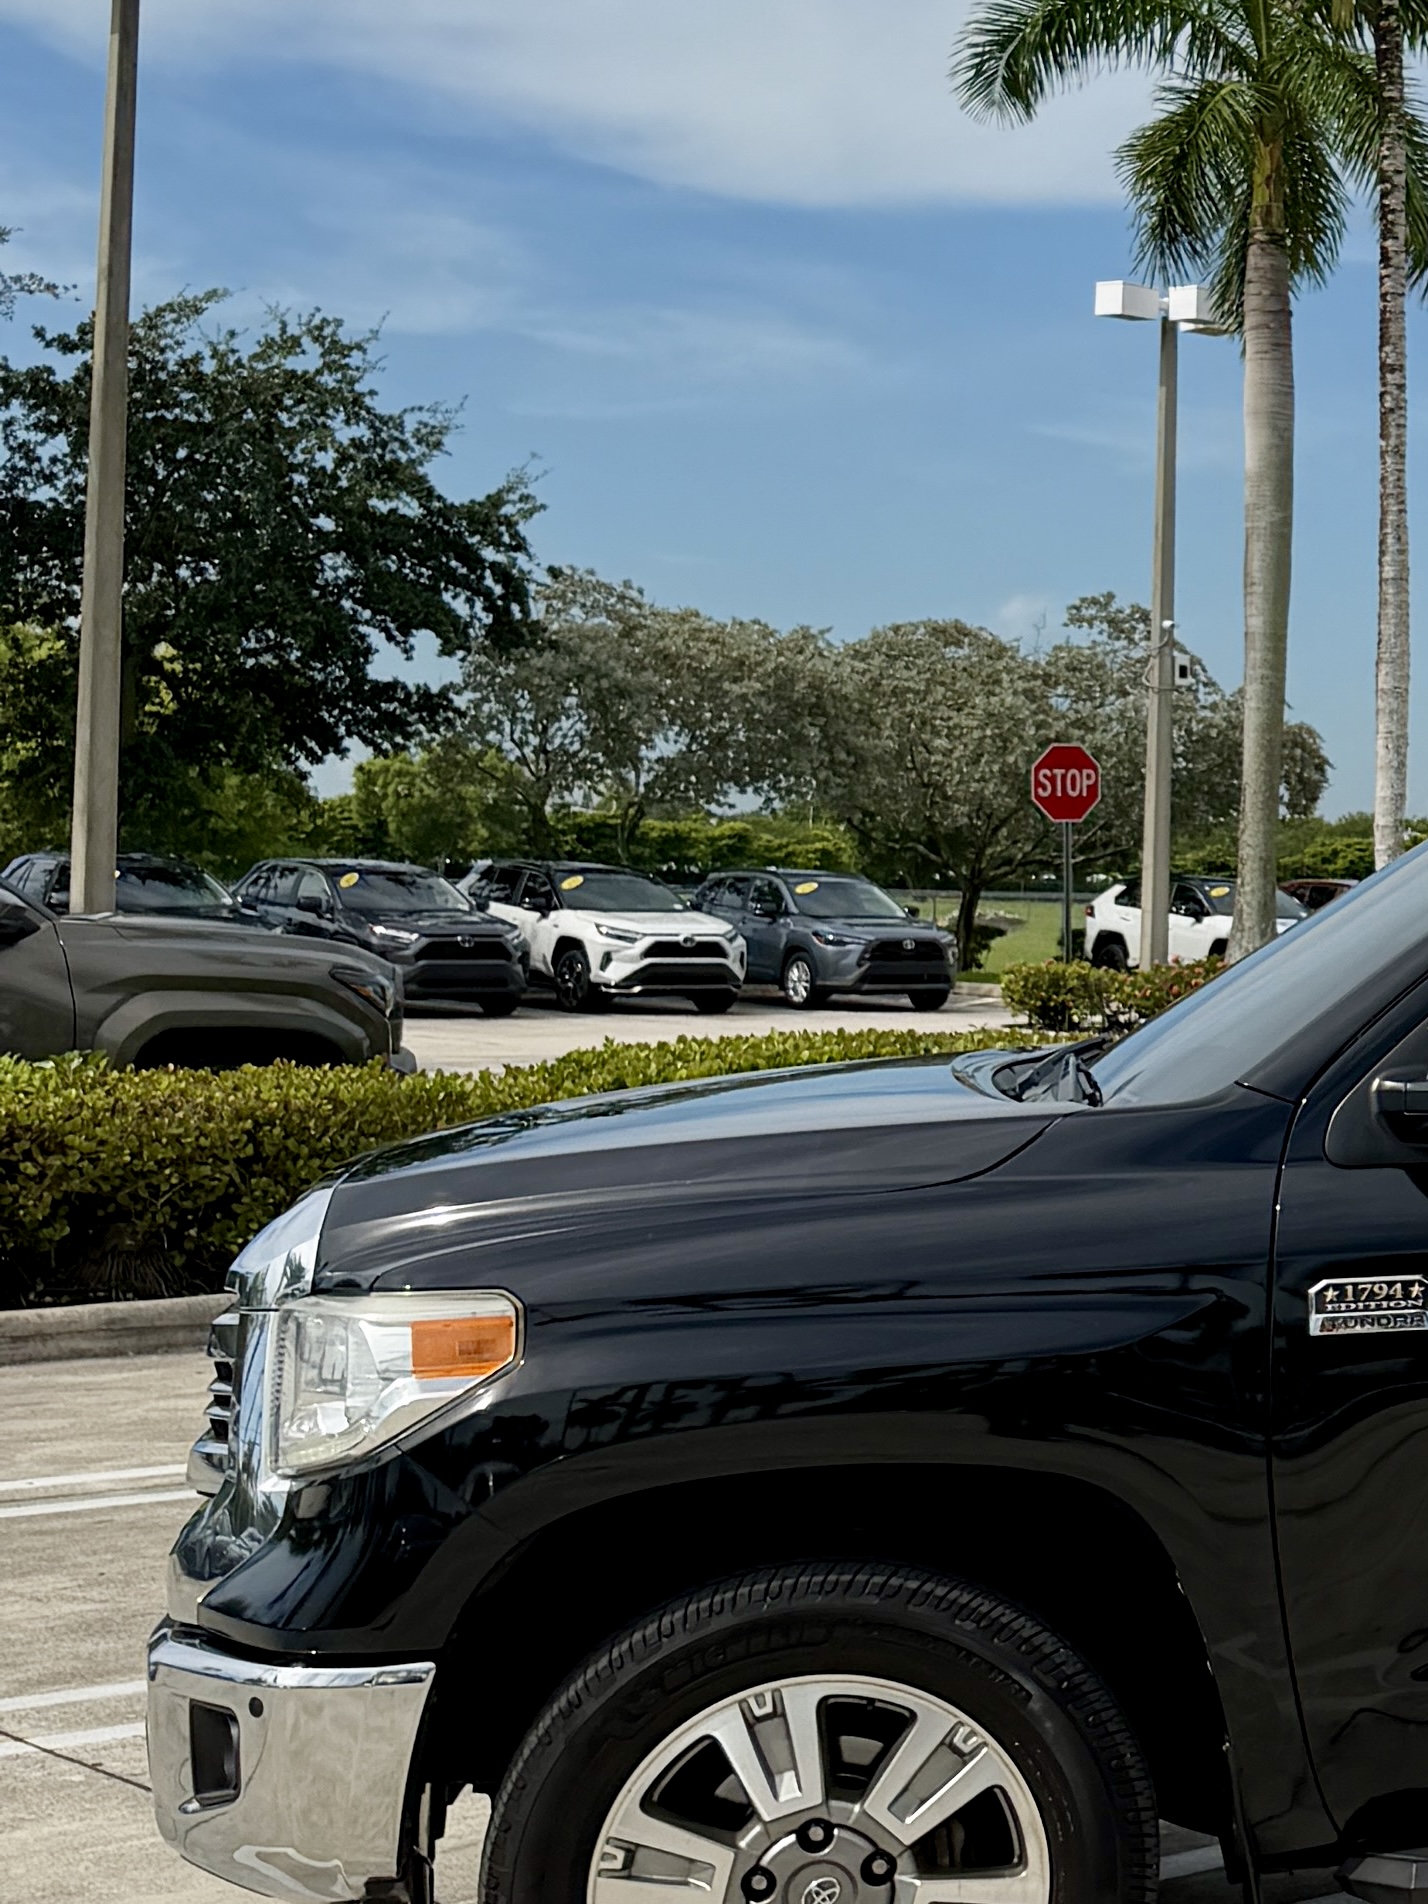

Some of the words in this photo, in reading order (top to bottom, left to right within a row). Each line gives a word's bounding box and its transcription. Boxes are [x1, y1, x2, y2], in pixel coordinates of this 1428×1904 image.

[1037, 768, 1096, 798] STOP
[1344, 1282, 1405, 1302] 1794
[1324, 1299, 1424, 1312] EDITION
[1319, 1311, 1427, 1333] TUNDRA
